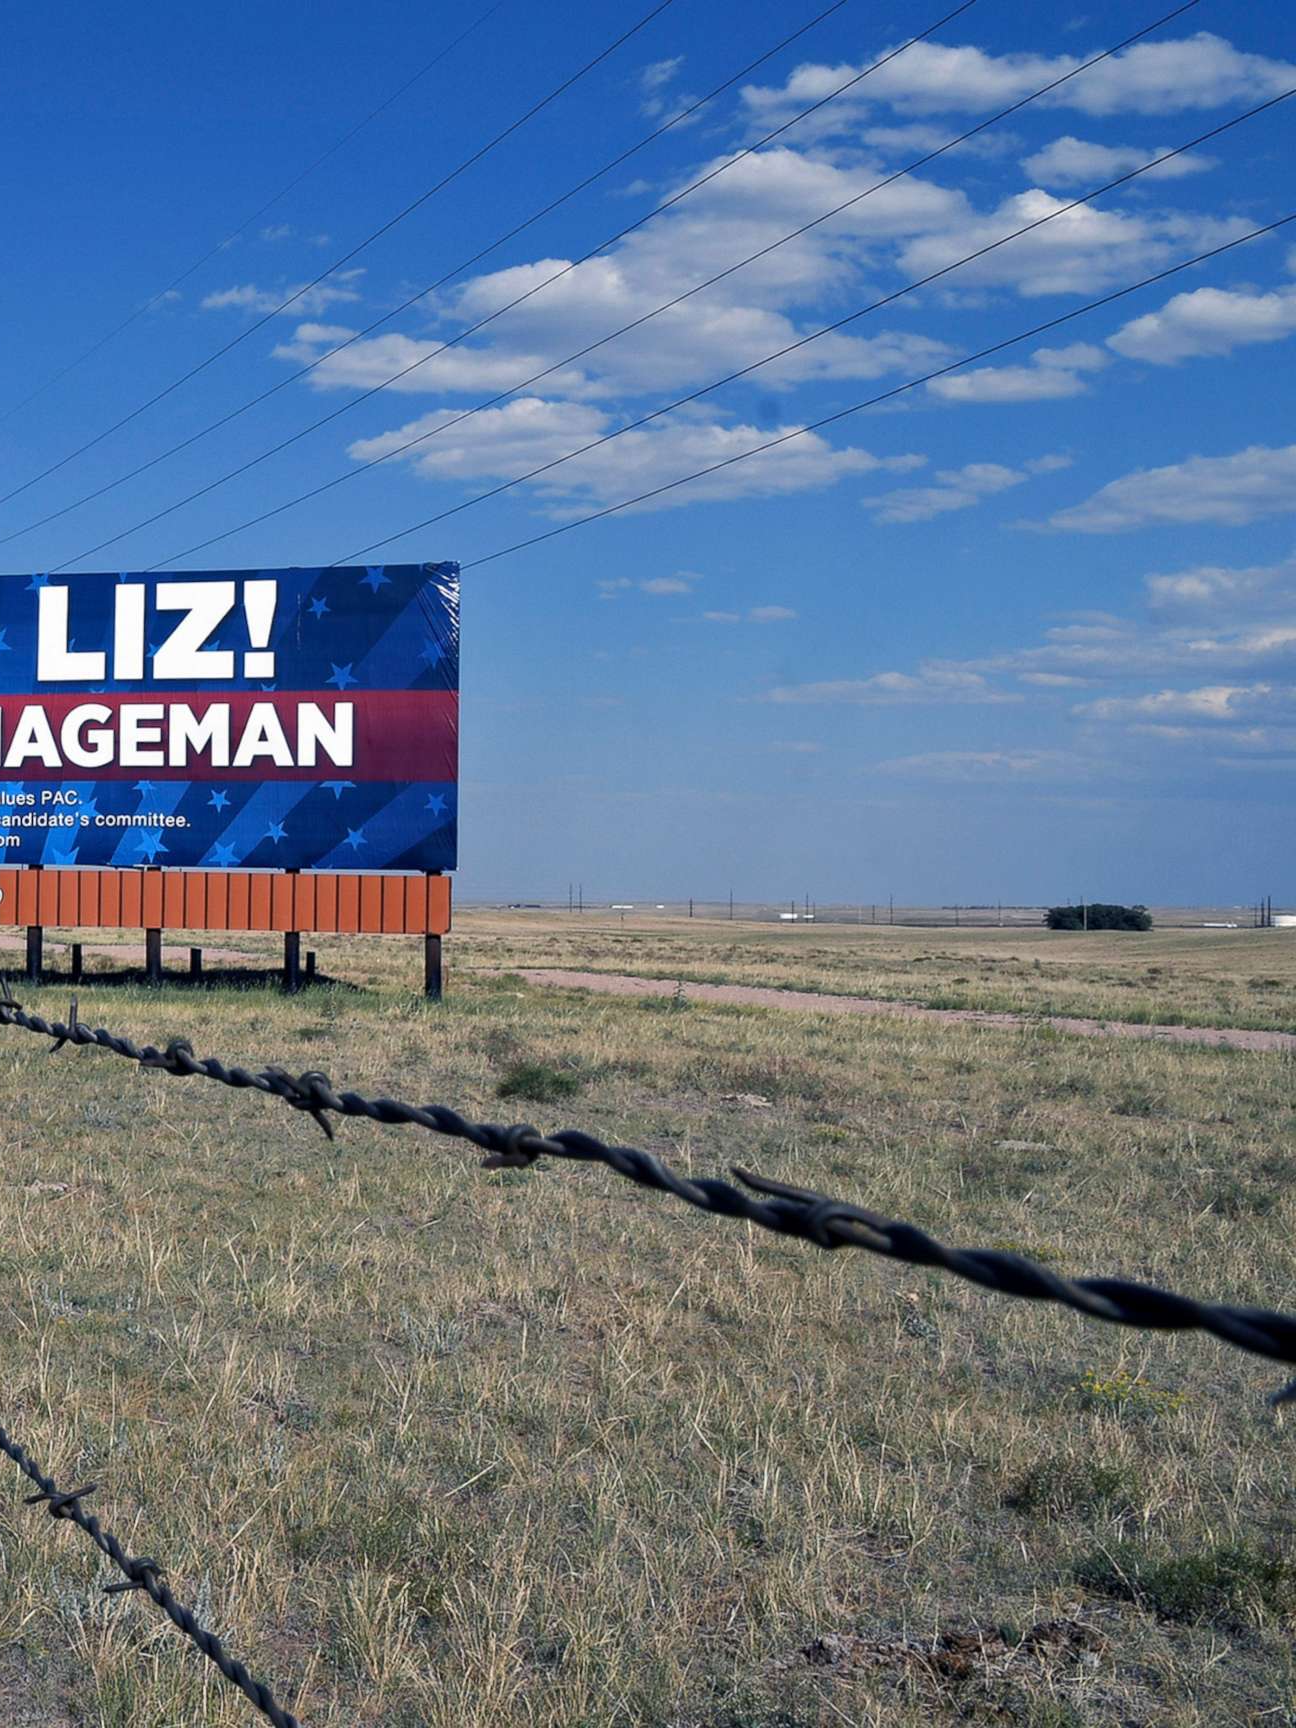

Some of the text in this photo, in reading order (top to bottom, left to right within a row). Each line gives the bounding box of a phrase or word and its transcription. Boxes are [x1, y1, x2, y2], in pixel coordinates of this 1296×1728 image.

[37, 579, 277, 681] LIZ!
[41, 791, 83, 805] PAC.
[95, 812, 191, 827] committee.
